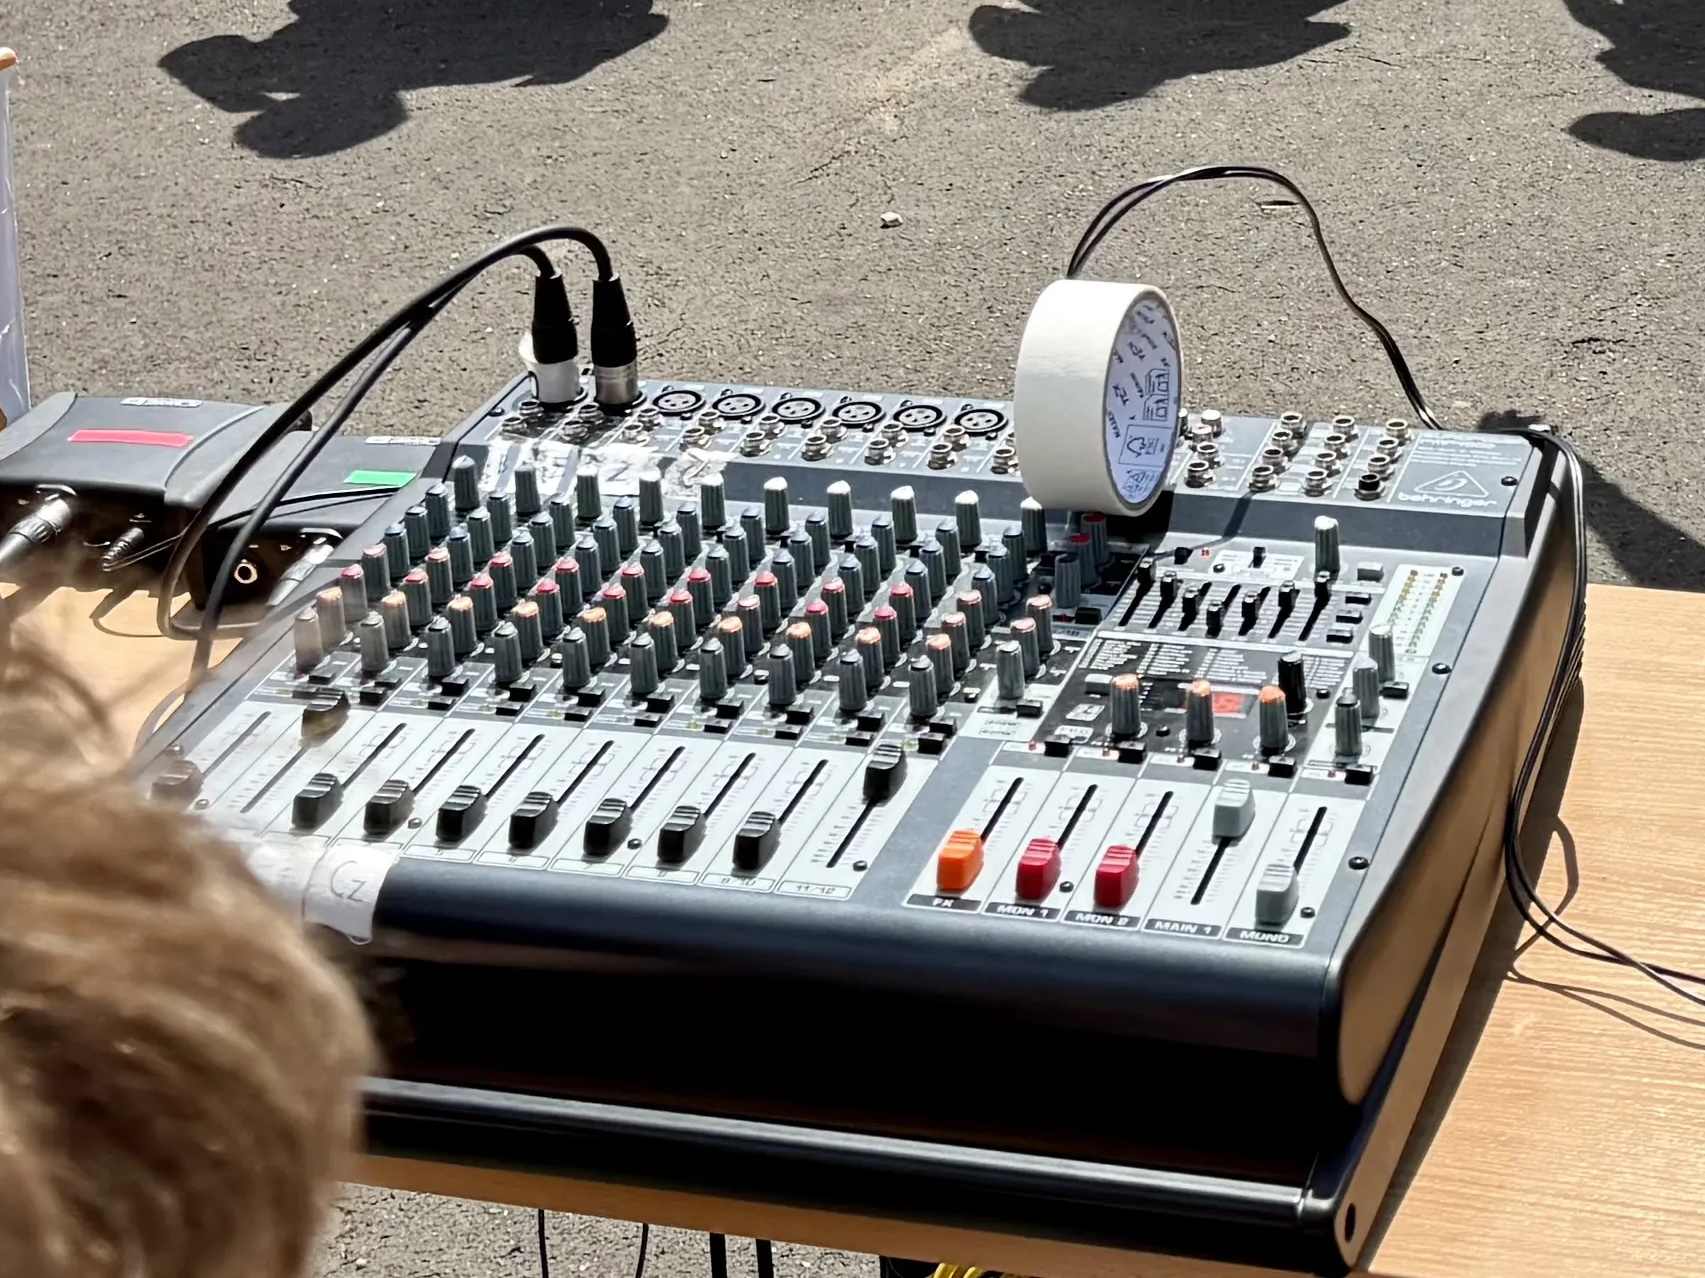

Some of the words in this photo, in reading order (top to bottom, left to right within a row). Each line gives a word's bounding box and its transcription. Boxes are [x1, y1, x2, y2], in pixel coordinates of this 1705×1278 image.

[1398, 492, 1498, 508] behringer
[932, 897, 954, 908] FX
[997, 905, 1035, 918] MON
[1075, 912, 1114, 925] MON
[1154, 920, 1199, 934] MAIN
[1239, 929, 1290, 944] MONO
